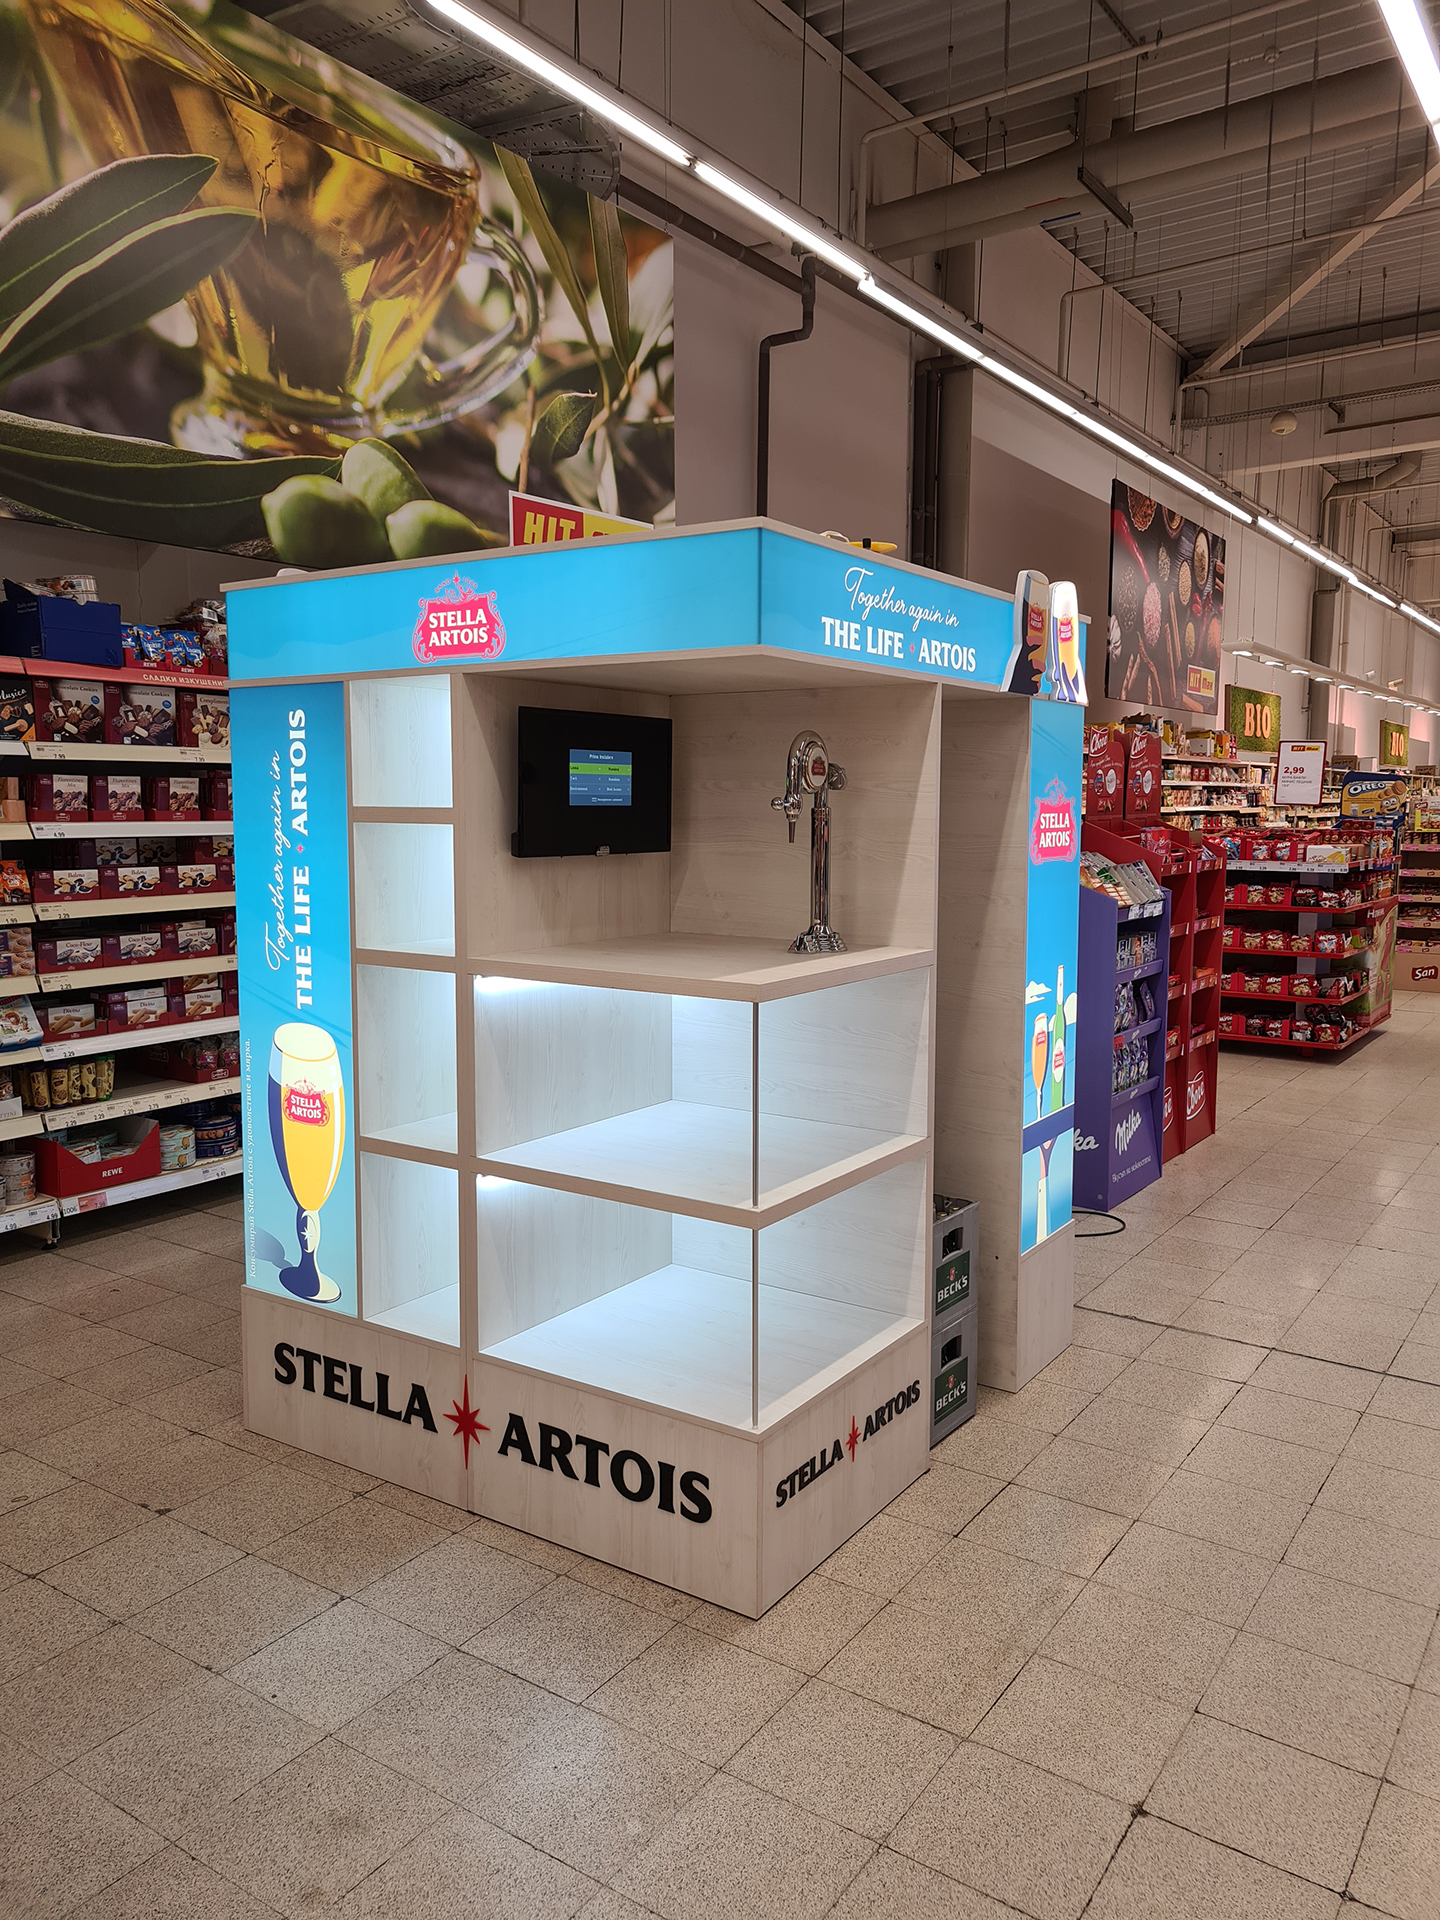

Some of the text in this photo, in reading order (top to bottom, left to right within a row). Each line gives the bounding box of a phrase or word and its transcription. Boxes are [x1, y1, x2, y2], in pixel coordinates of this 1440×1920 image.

[523, 511, 576, 544] HIT
[844, 567, 959, 632] Together again in
[429, 608, 487, 629] STELLA
[428, 627, 488, 647] ARTOIS
[821, 616, 976, 672] THE LIFE ARTOIS
[143, 674, 177, 683] СЛАДКИ
[1189, 671, 1201, 690] HIT
[1244, 702, 1272, 739] BIO
[1390, 731, 1404, 757] BIO
[1283, 766, 1305, 775] 2,99
[1349, 782, 1386, 795] OREO
[1040, 812, 1070, 830] STELLA
[1039, 831, 1070, 849] ARTOIS
[264, 750, 294, 971] Together again in
[288, 708, 313, 1010] THE LIFE ARTOIS
[1414, 968, 1435, 980] San
[290, 1094, 321, 1109] STELLA
[290, 1105, 322, 1119] ARTOIS
[1115, 1108, 1142, 1156] Milka
[102, 1166, 124, 1178] REWE
[248, 1216, 257, 1279] Консумирай
[937, 1274, 968, 1303] BECK'S
[935, 1380, 966, 1412] BECK'S
[274, 1341, 713, 1524] STELLA ARTOIS
[776, 1379, 921, 1508] STELLA ARTOIS
